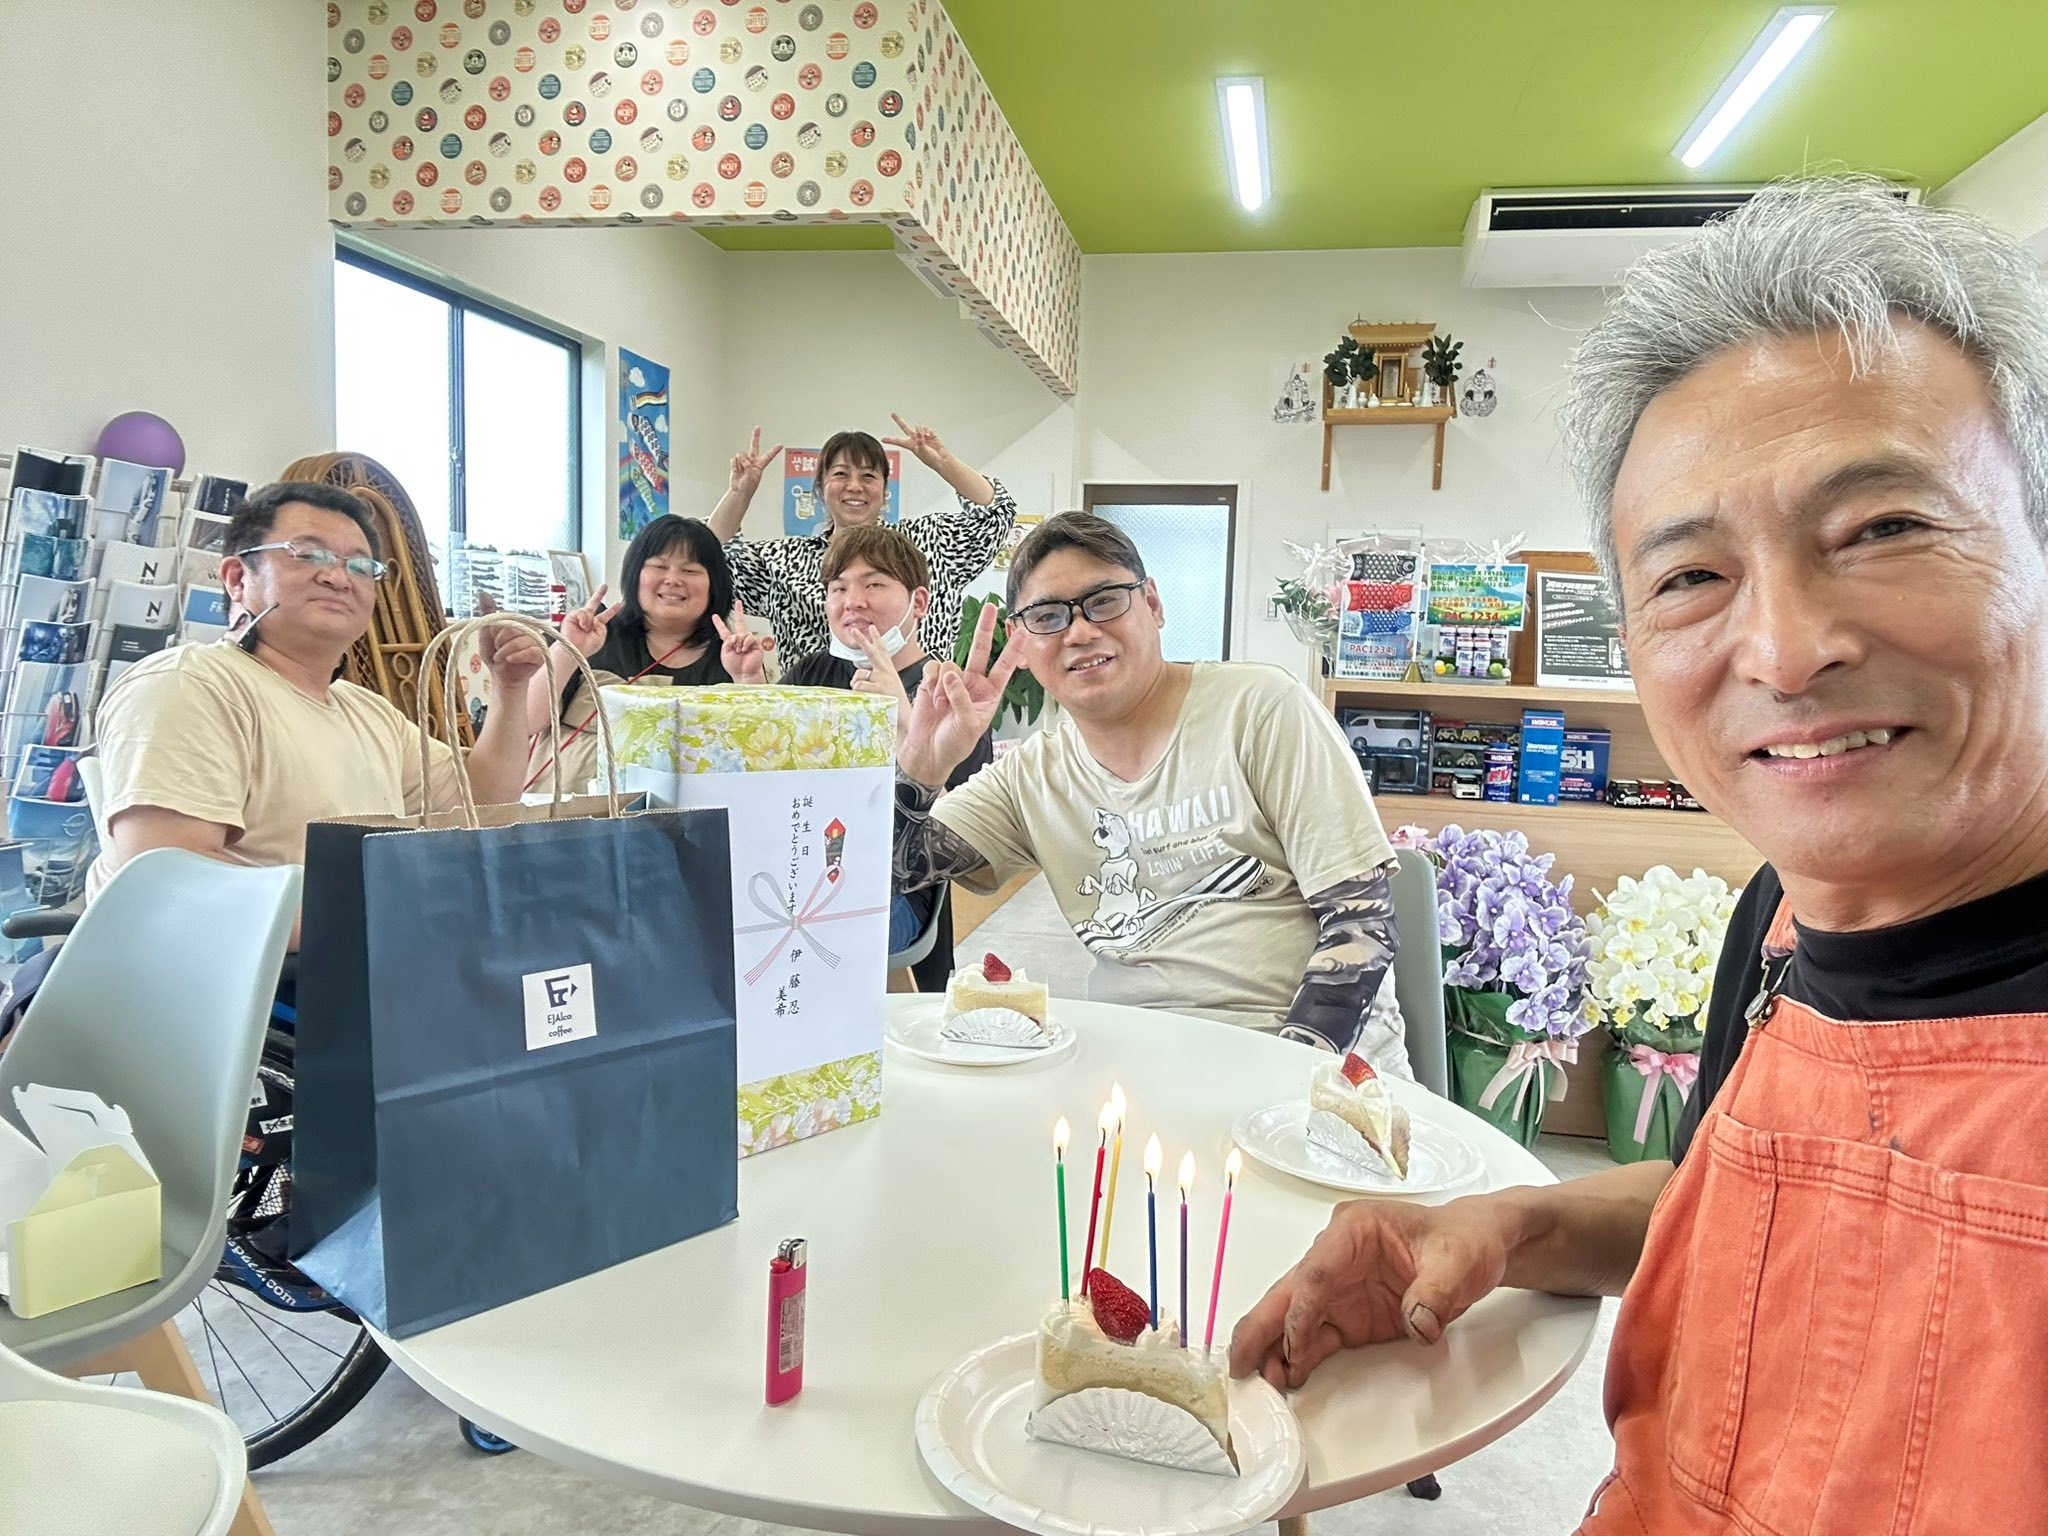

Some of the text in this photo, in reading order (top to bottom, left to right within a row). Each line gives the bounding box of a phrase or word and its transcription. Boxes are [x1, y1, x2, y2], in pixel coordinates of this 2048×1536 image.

[142, 561, 158, 578] N
[147, 601, 162, 617] N
[1444, 611, 1500, 621] PAC 1234
[1127, 785, 1231, 842] HAWAII
[802, 795, 813, 857] 誕生日
[786, 797, 801, 915] おめでとうございます
[1191, 838, 1230, 865] LIFE
[548, 1025, 573, 1038] coffee
